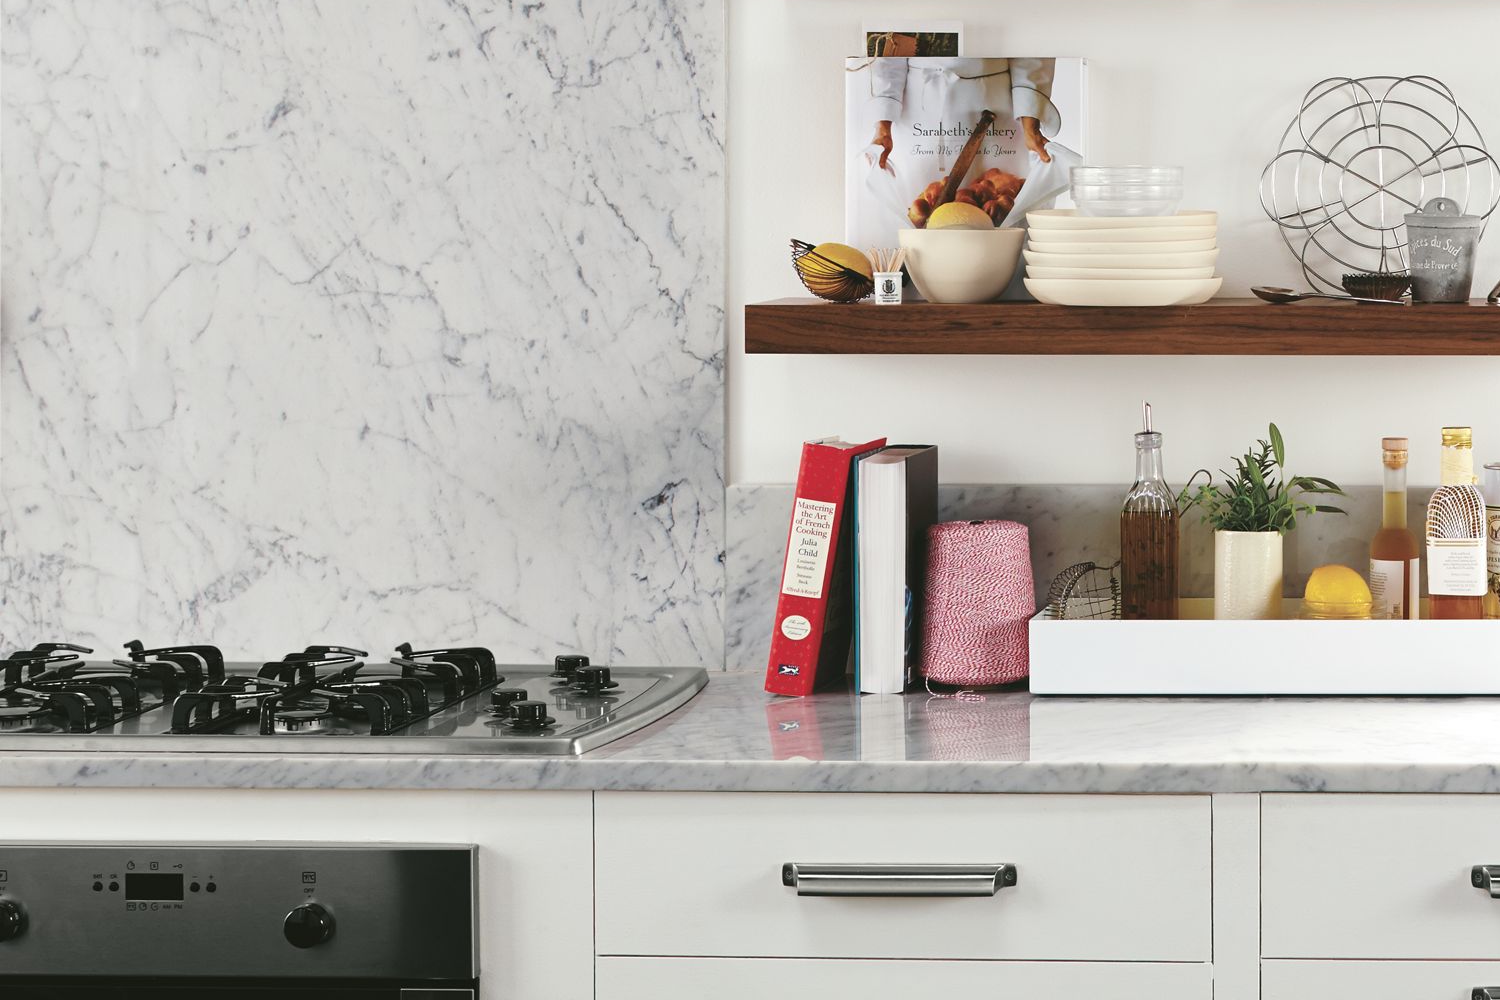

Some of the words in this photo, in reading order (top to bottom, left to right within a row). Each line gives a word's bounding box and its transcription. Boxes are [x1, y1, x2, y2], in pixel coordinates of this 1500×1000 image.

[913, 122, 972, 137] Sarabeth's
[912, 144, 934, 155] From
[937, 144, 953, 156] My
[983, 147, 991, 155] to
[991, 144, 1017, 157] Yours
[1443, 238, 1462, 256] Sud
[798, 501, 834, 514] Mastering
[801, 511, 813, 519] the
[814, 512, 827, 521] Art
[805, 519, 830, 529] French
[795, 526, 828, 539] Cooking
[801, 538, 818, 547] Julia
[798, 548, 818, 557] Child
